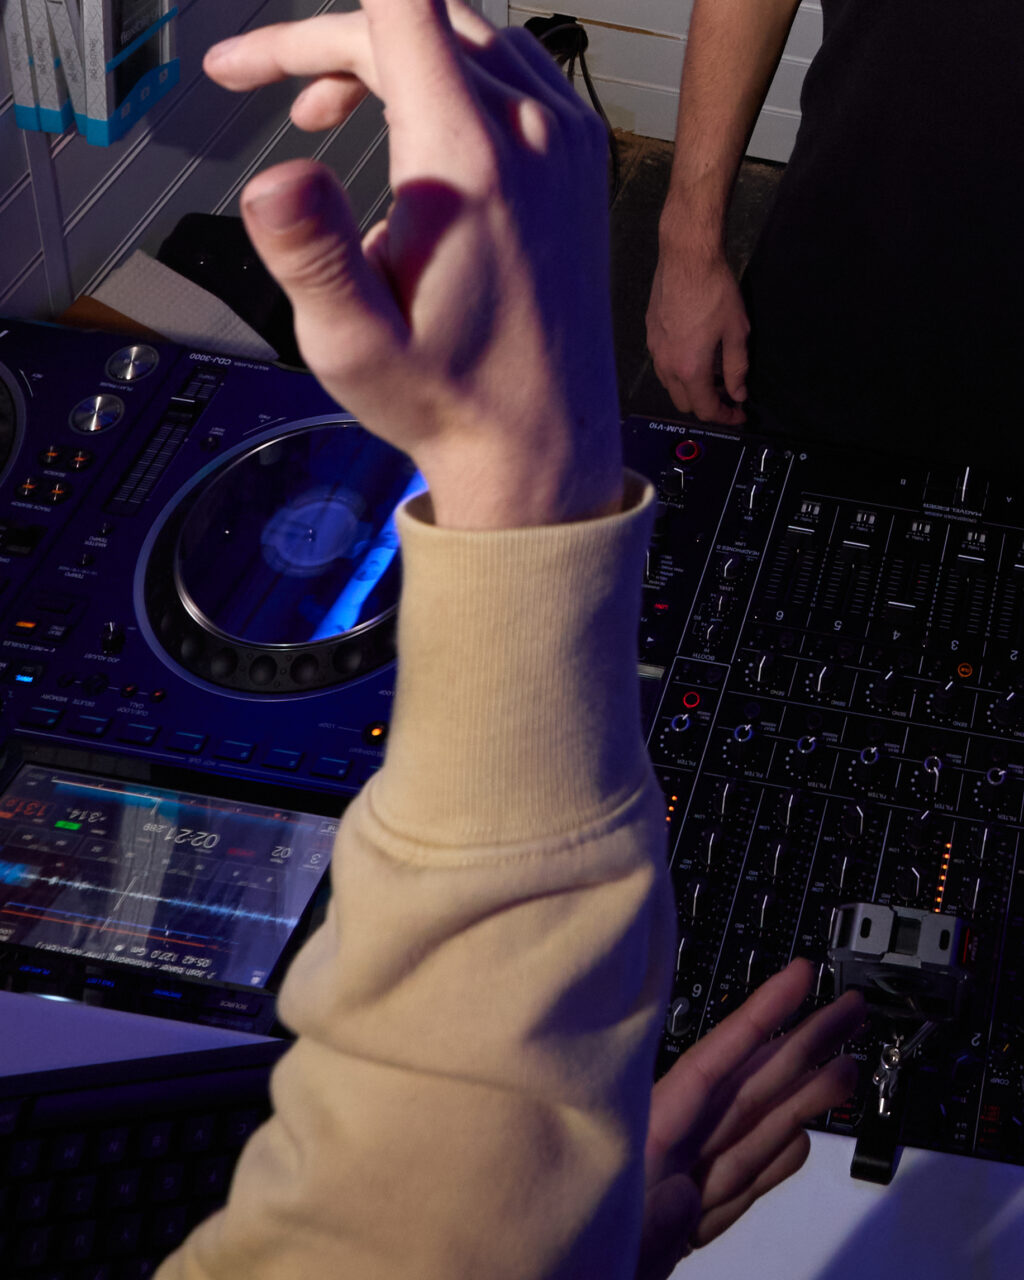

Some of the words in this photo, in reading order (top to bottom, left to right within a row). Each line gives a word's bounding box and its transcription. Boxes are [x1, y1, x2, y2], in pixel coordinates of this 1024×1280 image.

[189, 353, 232, 366] CDJ-3000
[649, 421, 686, 434] DJM-V10
[774, 609, 785, 622] 6
[832, 619, 843, 632] 5
[892, 629, 902, 641] 4
[950, 639, 960, 651] 3
[692, 652, 716, 661] BOOTH
[1009, 649, 1019, 661] 2
[271, 846, 293, 859] 02
[182, 955, 212, 968] 05:42
[692, 983, 703, 997] 6
[970, 1032, 982, 1047] 2
[990, 1077, 1010, 1086] COMP
